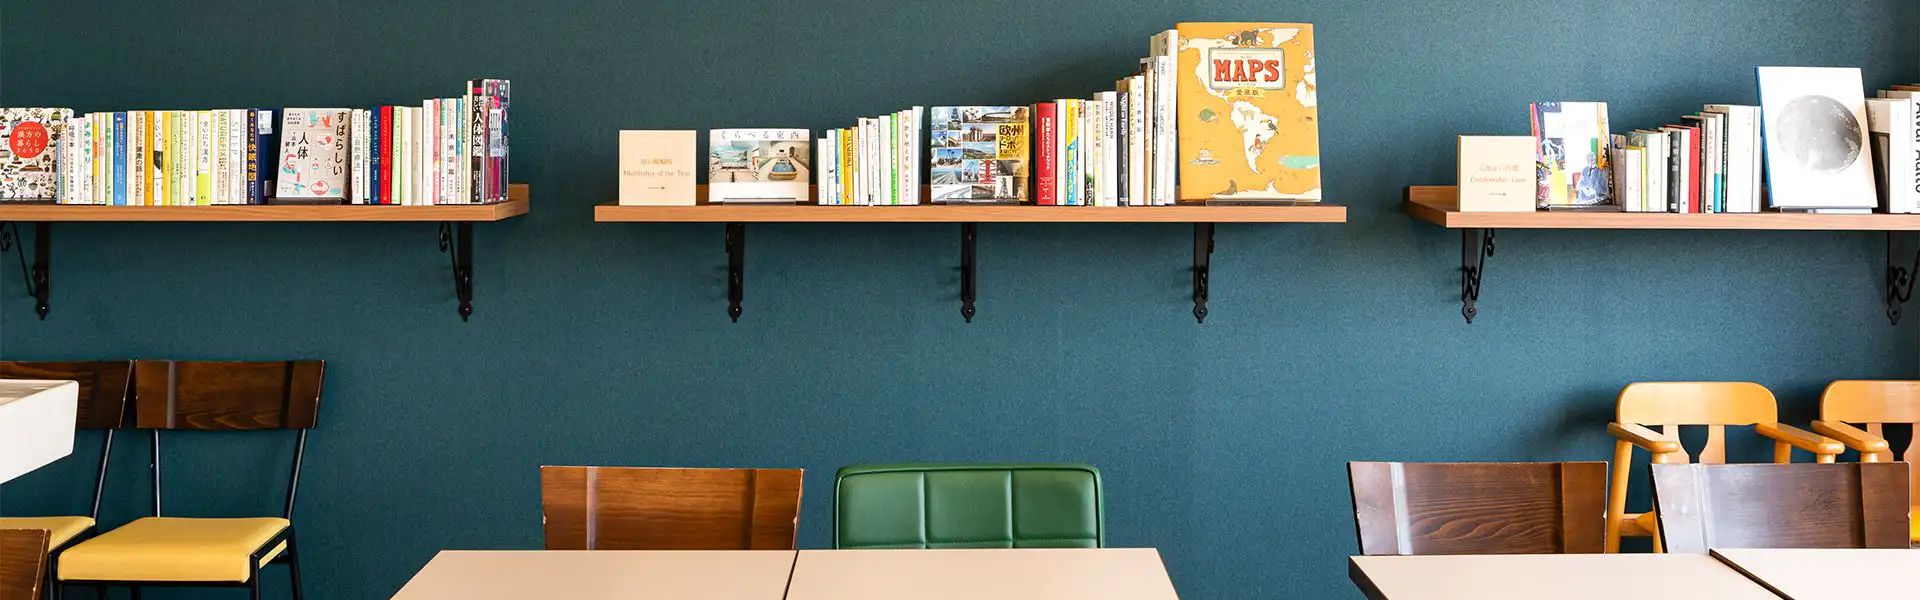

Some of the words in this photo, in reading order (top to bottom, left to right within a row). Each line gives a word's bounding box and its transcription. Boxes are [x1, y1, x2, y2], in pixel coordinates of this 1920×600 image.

[1213, 59, 1279, 82] MAPS
[472, 112, 484, 157] 人体図鑑
[721, 131, 799, 139] くらべる東西
[999, 124, 1024, 136] 欧州
[297, 131, 309, 160] 人体
[333, 111, 347, 176] すばらしい
